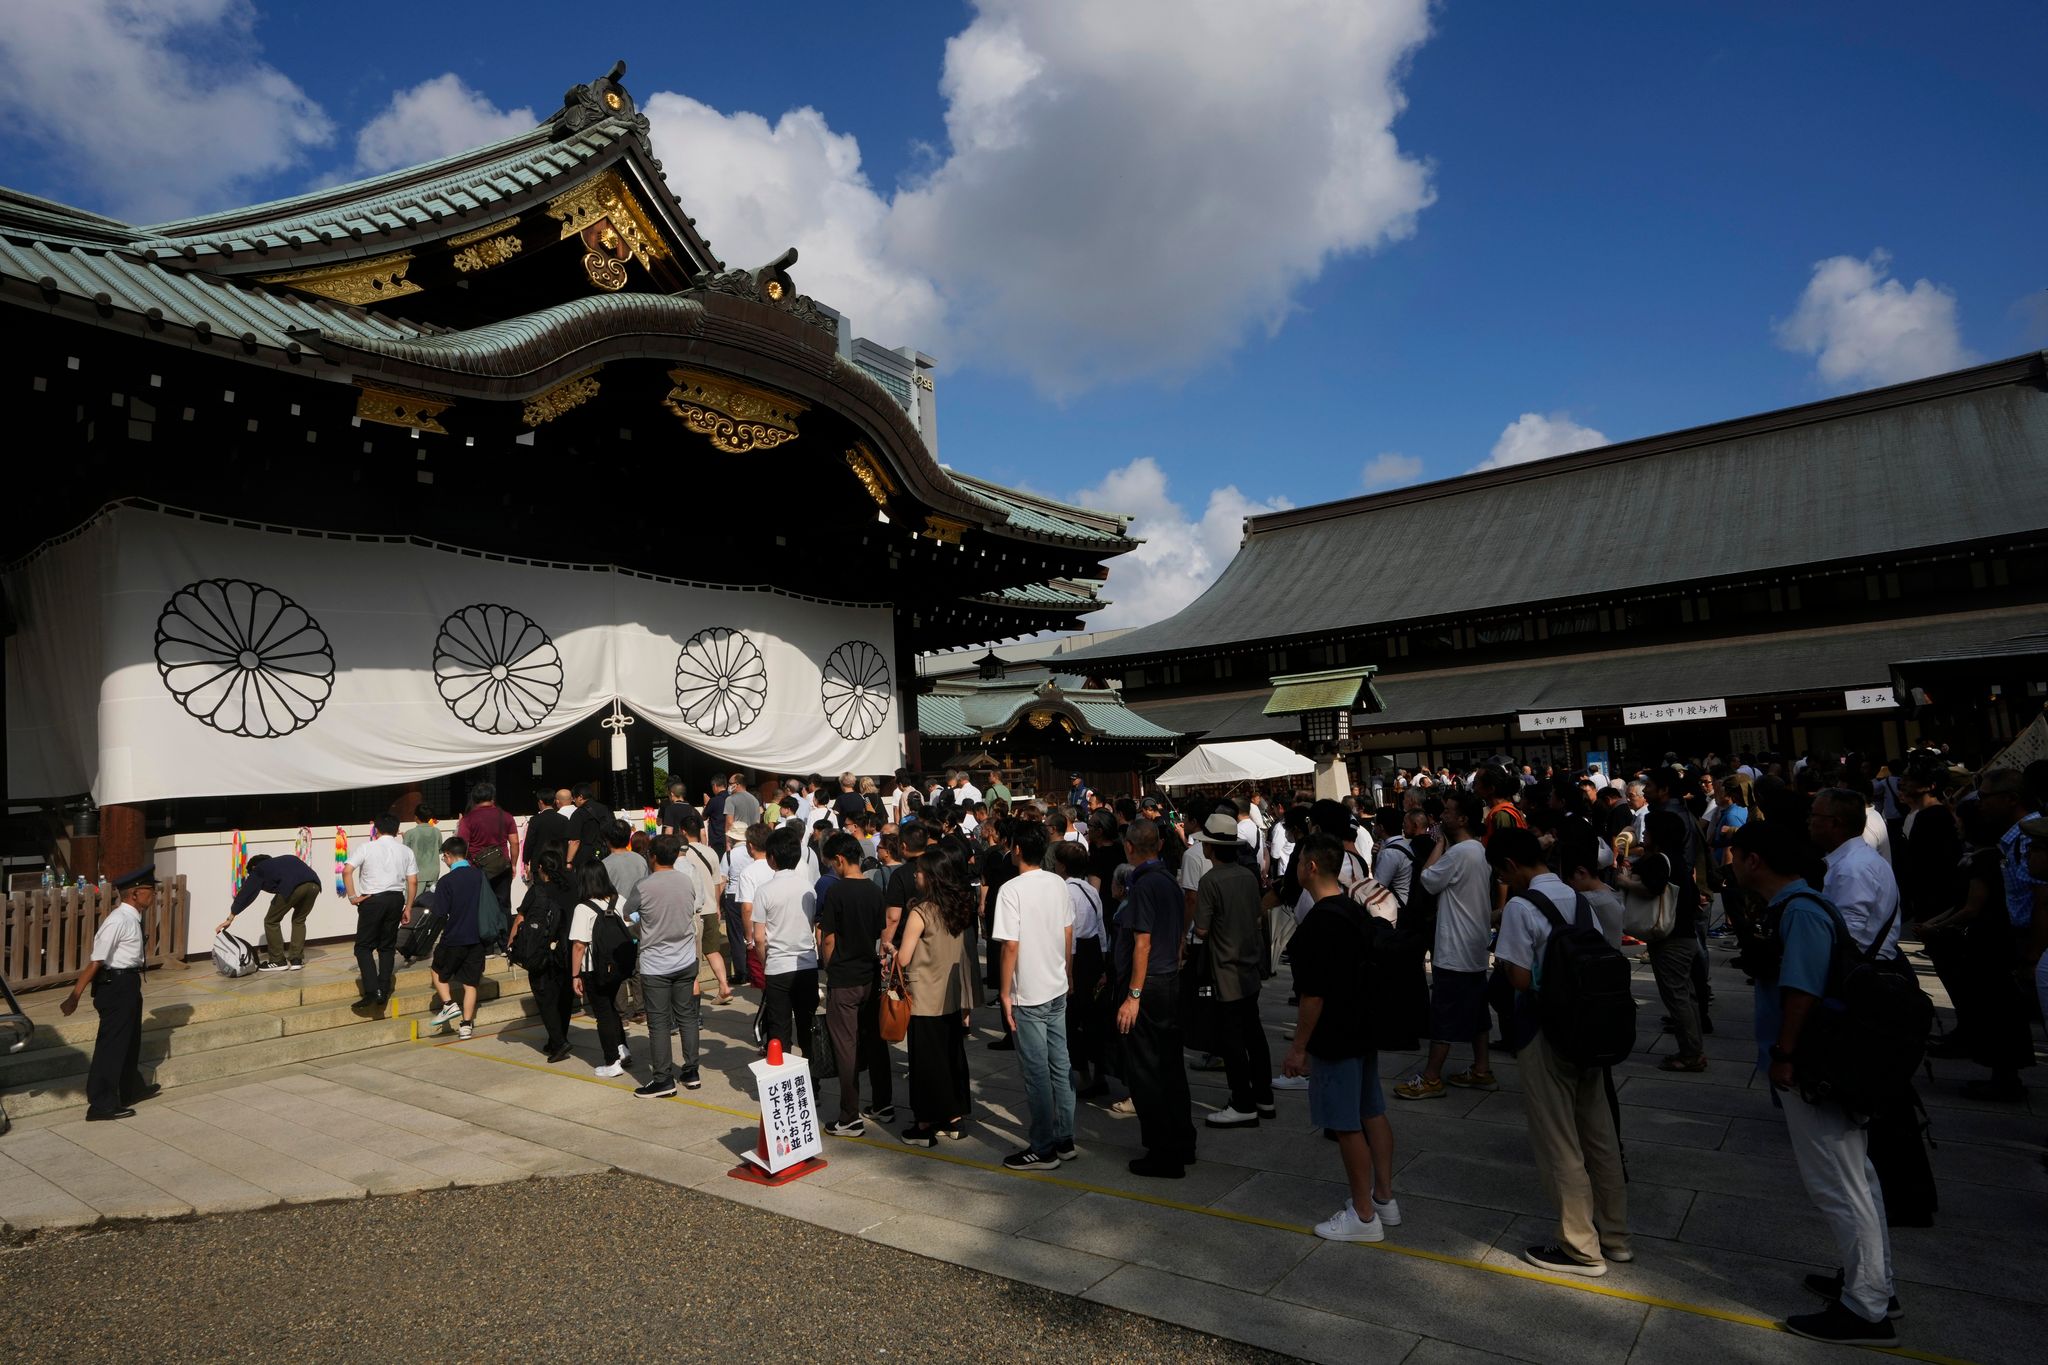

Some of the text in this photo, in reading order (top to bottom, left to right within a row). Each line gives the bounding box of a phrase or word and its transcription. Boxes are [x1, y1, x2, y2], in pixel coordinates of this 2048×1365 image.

[1534, 715, 1568, 726] 朱印所
[1860, 694, 1894, 704] おみ
[768, 1083, 786, 1134] び下さい。
[781, 1078, 802, 1150] 列後方にお並
[794, 1074, 814, 1145] 御参拝の方は
